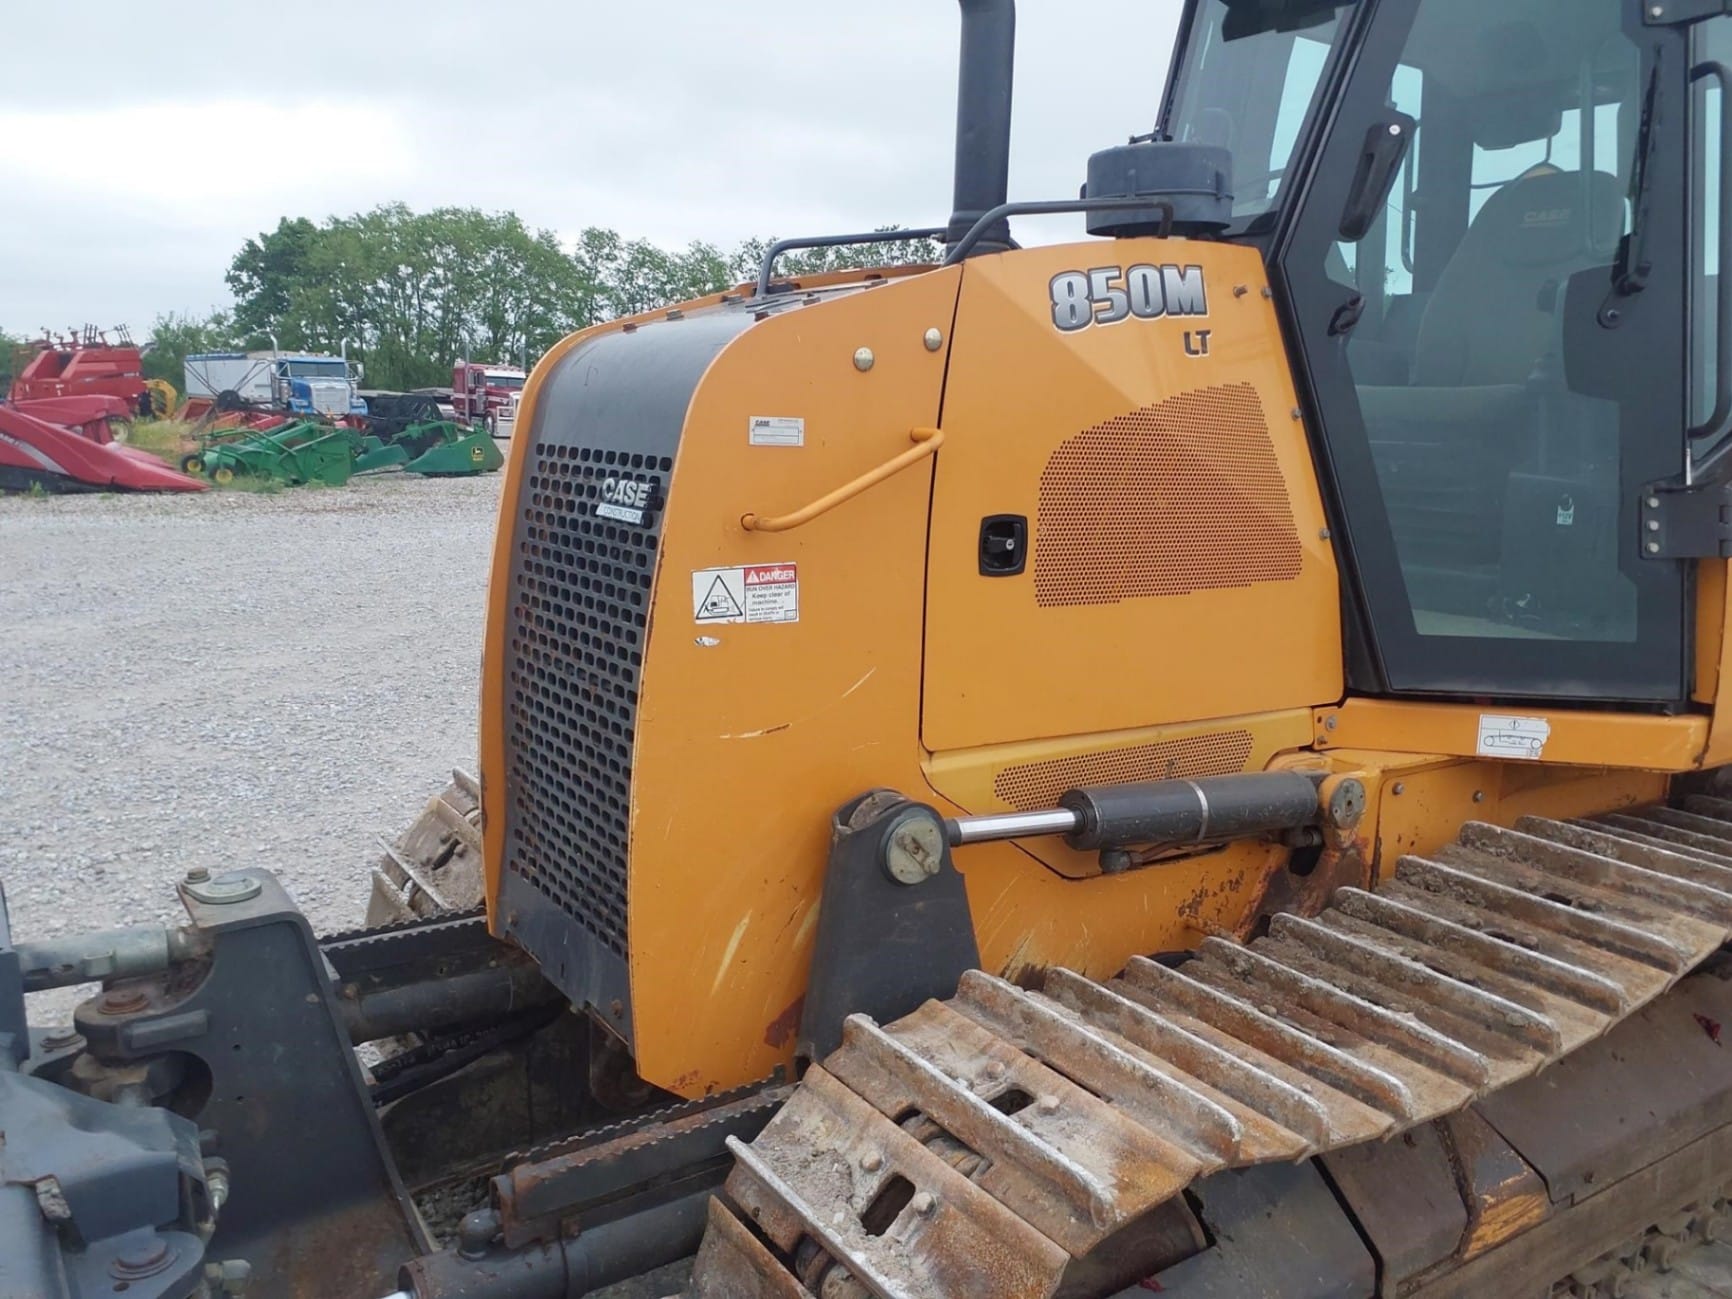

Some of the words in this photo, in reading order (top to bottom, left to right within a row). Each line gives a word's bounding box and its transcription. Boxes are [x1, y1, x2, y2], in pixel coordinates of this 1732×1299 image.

[1049, 264, 1208, 332] 850M
[1184, 330, 1211, 355] LT
[602, 478, 651, 508] CASE
[760, 570, 794, 581] DANGER
